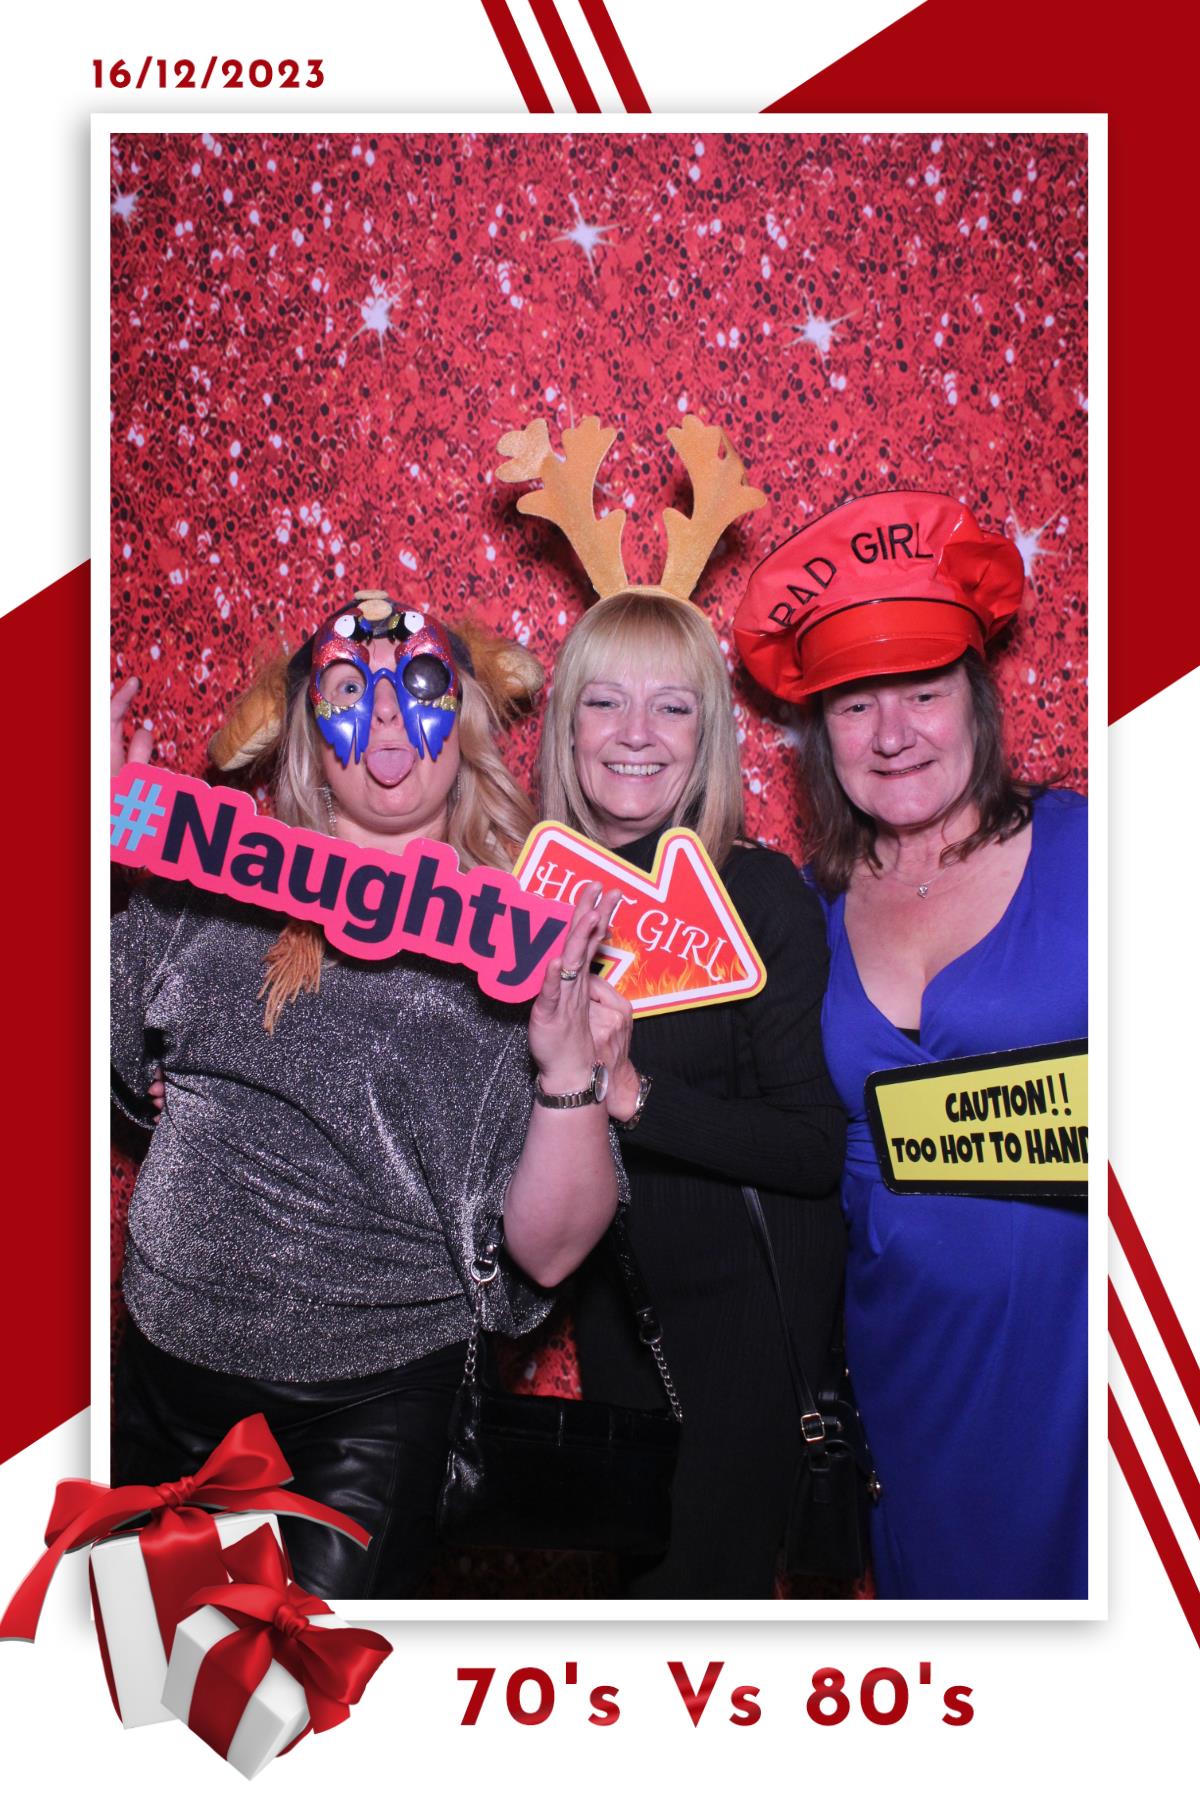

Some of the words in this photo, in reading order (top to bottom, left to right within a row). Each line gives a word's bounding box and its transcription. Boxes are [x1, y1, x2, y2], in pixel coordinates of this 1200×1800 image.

[767, 556, 837, 629] BAD
[851, 522, 934, 565] GIRL
[111, 778, 567, 986] #Naughty
[636, 908, 728, 982] GIRL
[945, 1072, 1072, 1123] CAUTION!!
[891, 1137, 937, 1163] TOO
[940, 1131, 985, 1164] HOT
[989, 1131, 1022, 1163] TO
